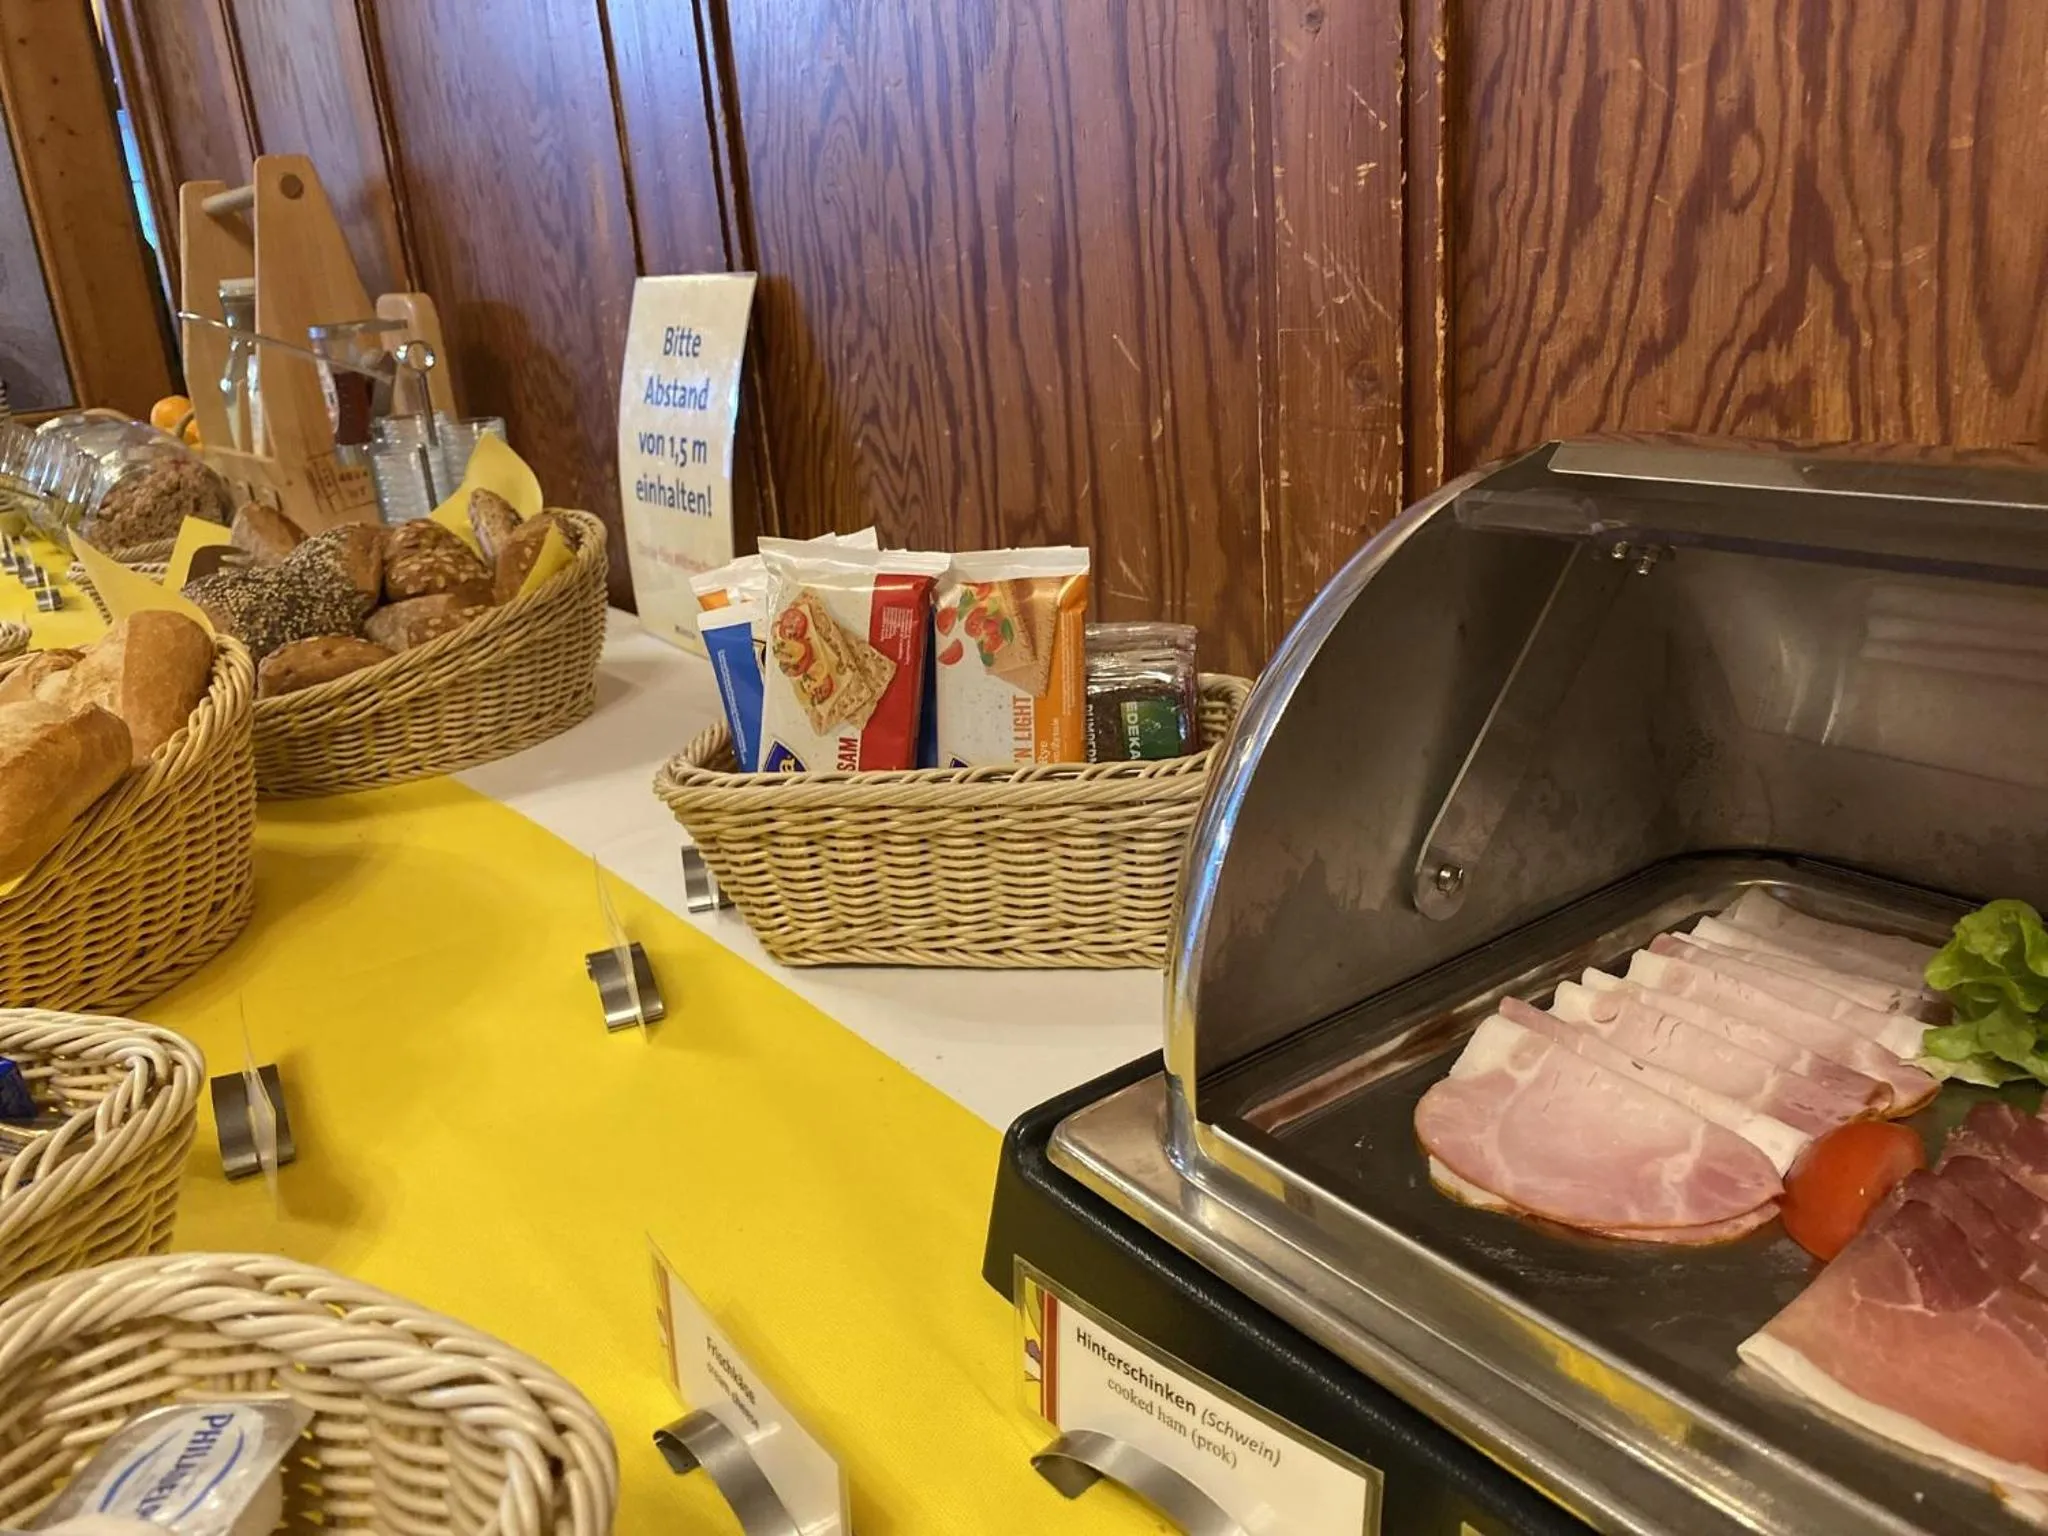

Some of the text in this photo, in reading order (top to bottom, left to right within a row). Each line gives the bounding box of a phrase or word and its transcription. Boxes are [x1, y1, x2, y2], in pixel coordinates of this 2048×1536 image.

[663, 327, 702, 357] Bitte
[644, 376, 710, 410] Abstand
[639, 431, 707, 467] von 1,5 m
[635, 473, 712, 518] einhalten!
[1013, 696, 1033, 741] LIGHT
[1126, 700, 1141, 760] EDEKA
[1076, 1327, 1282, 1468] Hinterschinken (Schwein)
[1107, 1377, 1238, 1470] cooked ham (prok)
